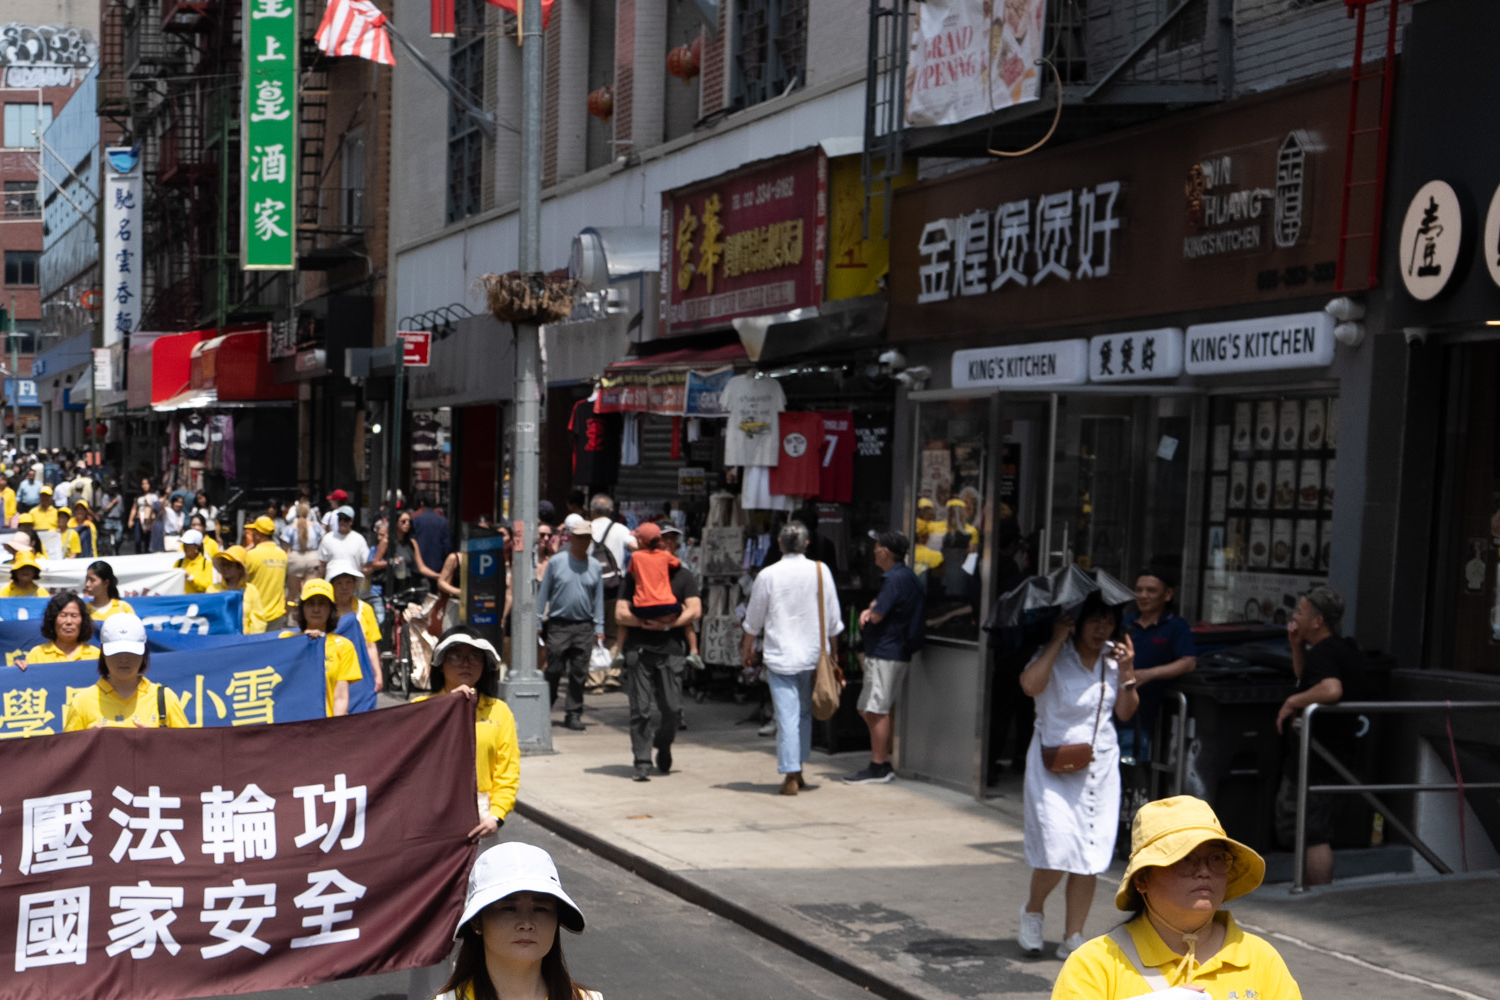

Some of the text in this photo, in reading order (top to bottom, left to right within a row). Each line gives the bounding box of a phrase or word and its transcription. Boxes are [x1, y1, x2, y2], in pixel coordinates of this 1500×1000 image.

[1190, 326, 1316, 363] KING'S KITCHEN
[968, 353, 1057, 381] KING'S KITCHEN
[822, 434, 839, 467] 7
[479, 554, 493, 575] P
